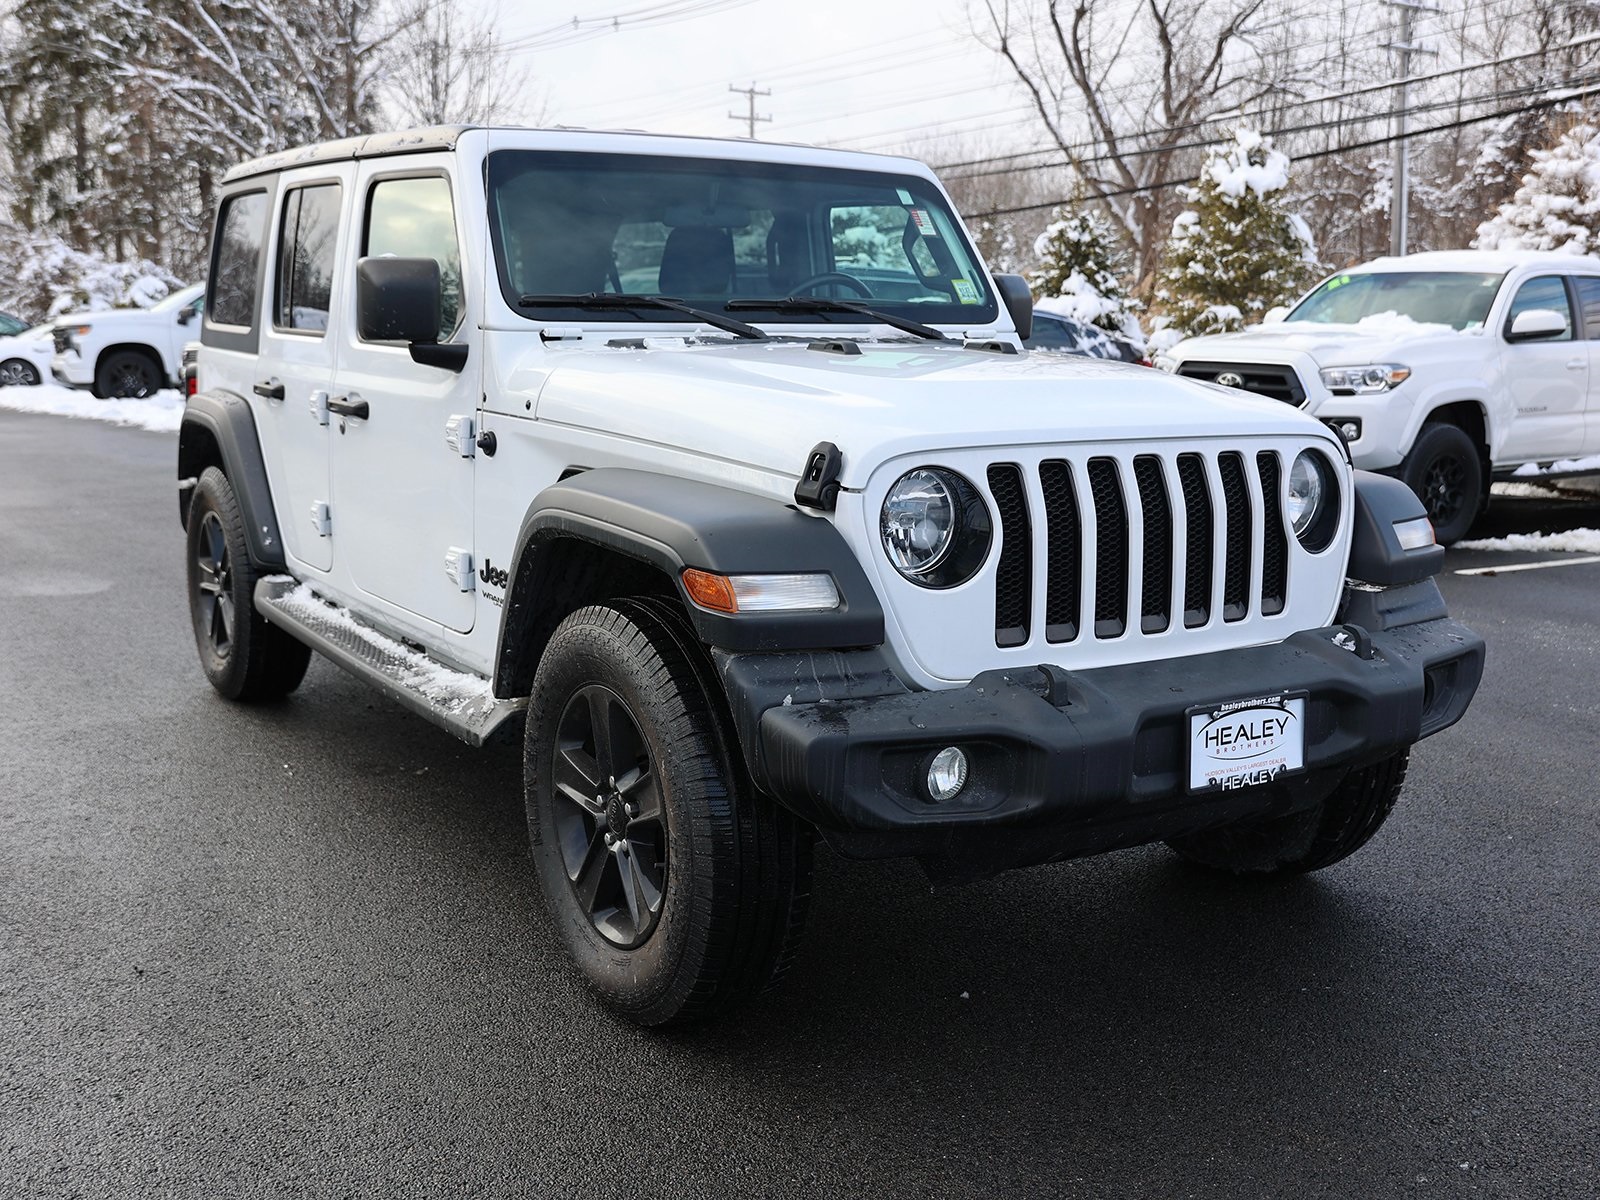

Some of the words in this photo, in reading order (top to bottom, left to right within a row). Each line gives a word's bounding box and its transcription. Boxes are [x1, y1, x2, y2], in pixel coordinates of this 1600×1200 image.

[480, 558, 508, 589] Jee
[1221, 696, 1281, 711] healeybrothers.com
[1205, 716, 1289, 748] HEALEY
[1216, 739, 1274, 755] BROTHERS
[1205, 768, 1225, 777] HUDSON
[1248, 761, 1268, 770] LARGEST
[1269, 757, 1286, 766] DEALER
[1221, 768, 1276, 791] HEALEY
